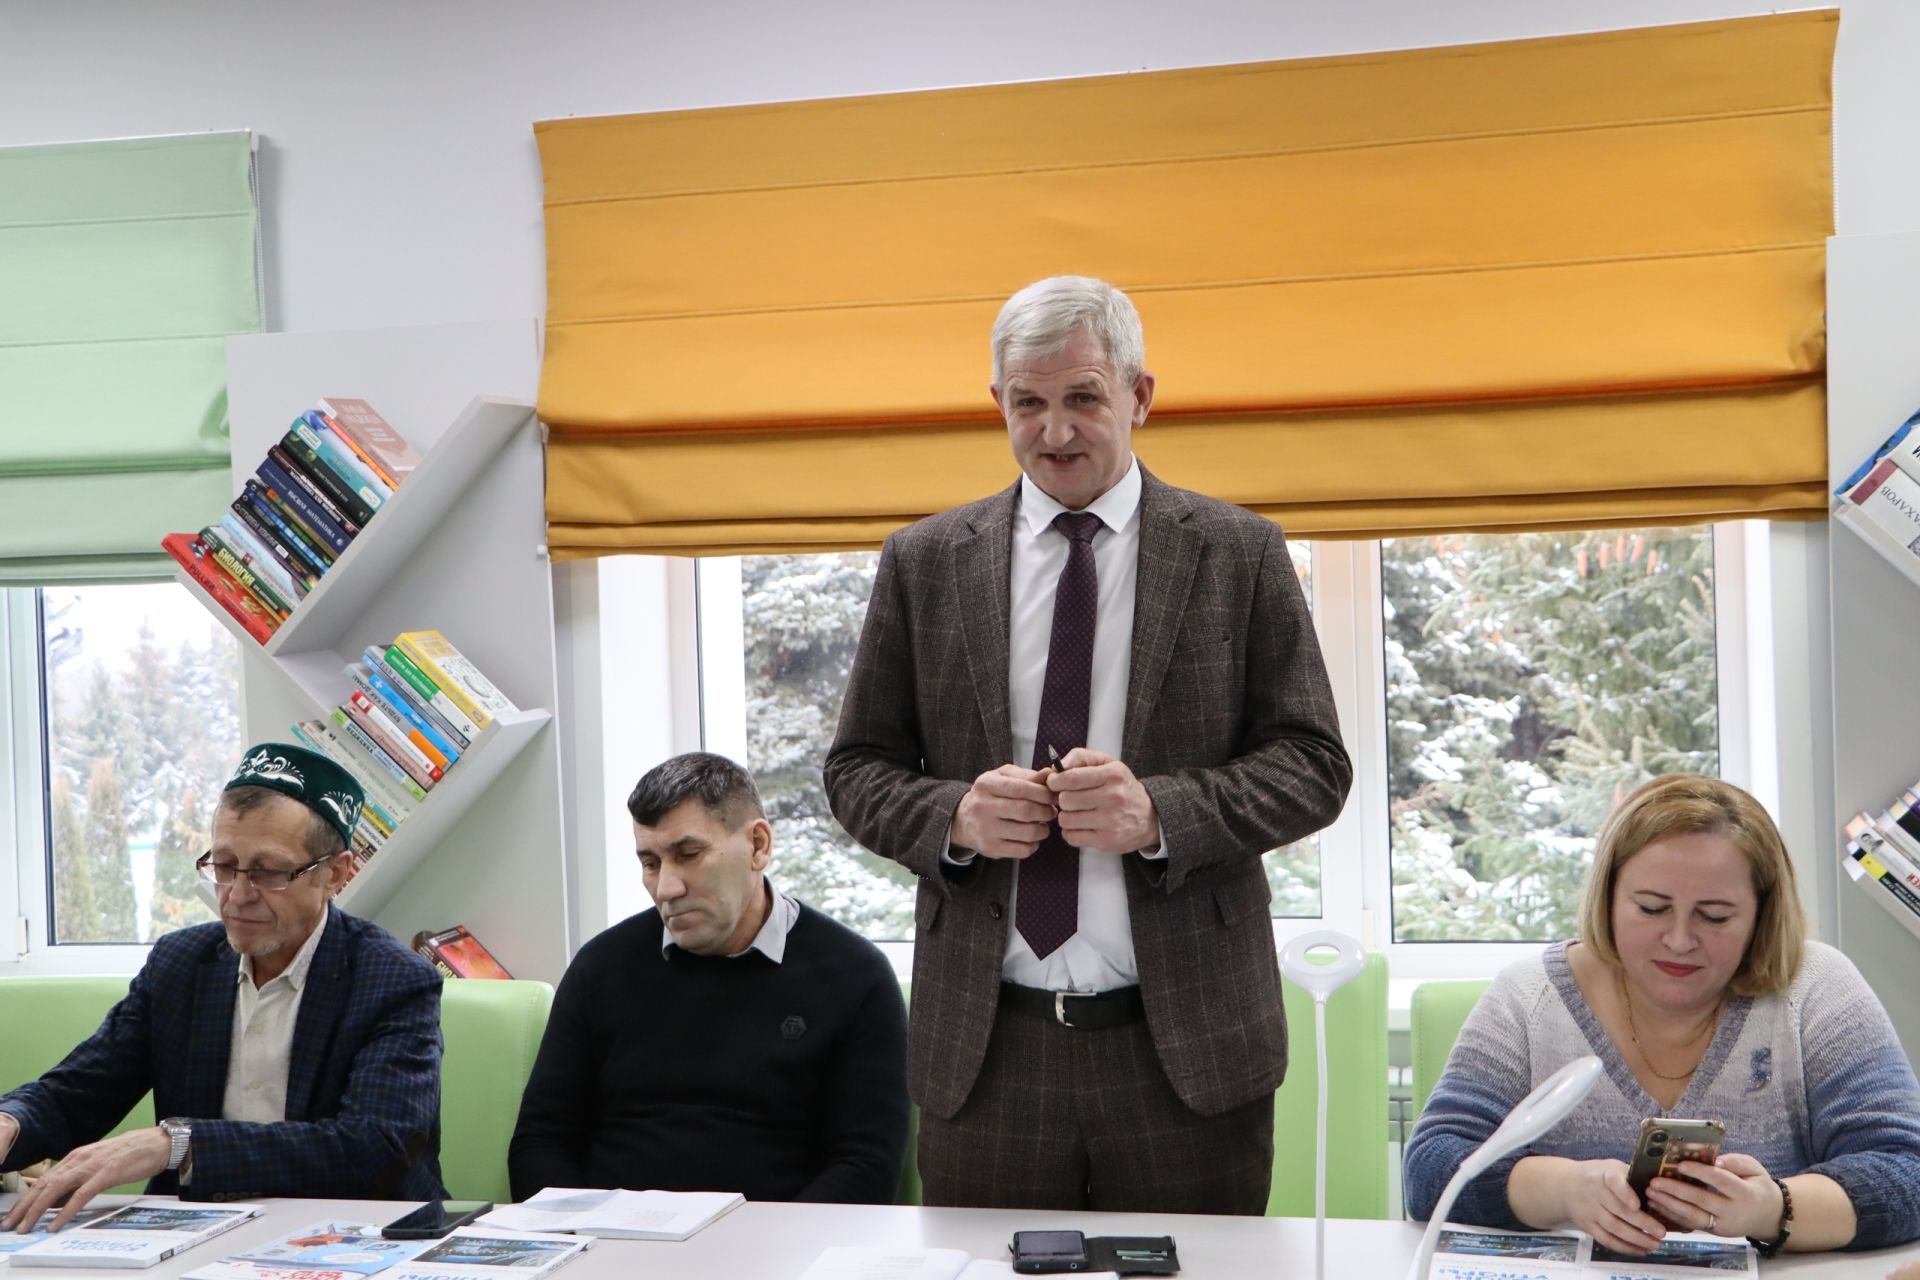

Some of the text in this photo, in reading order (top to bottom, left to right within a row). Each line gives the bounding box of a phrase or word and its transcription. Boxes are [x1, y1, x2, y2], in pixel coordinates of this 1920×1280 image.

[285, 488, 308, 510] ВЫСШАЯ
[304, 507, 337, 539] МАТЕМАТИКА
[1879, 483, 1920, 524] АХАРОВ
[237, 506, 261, 529] СТИВЕН
[187, 562, 217, 592] РОССИИ
[215, 546, 257, 587] БИОЛОГИЯ
[350, 672, 372, 693] ДОМА!
[368, 690, 383, 704] КАК
[379, 701, 402, 723] БУДЬТЕ
